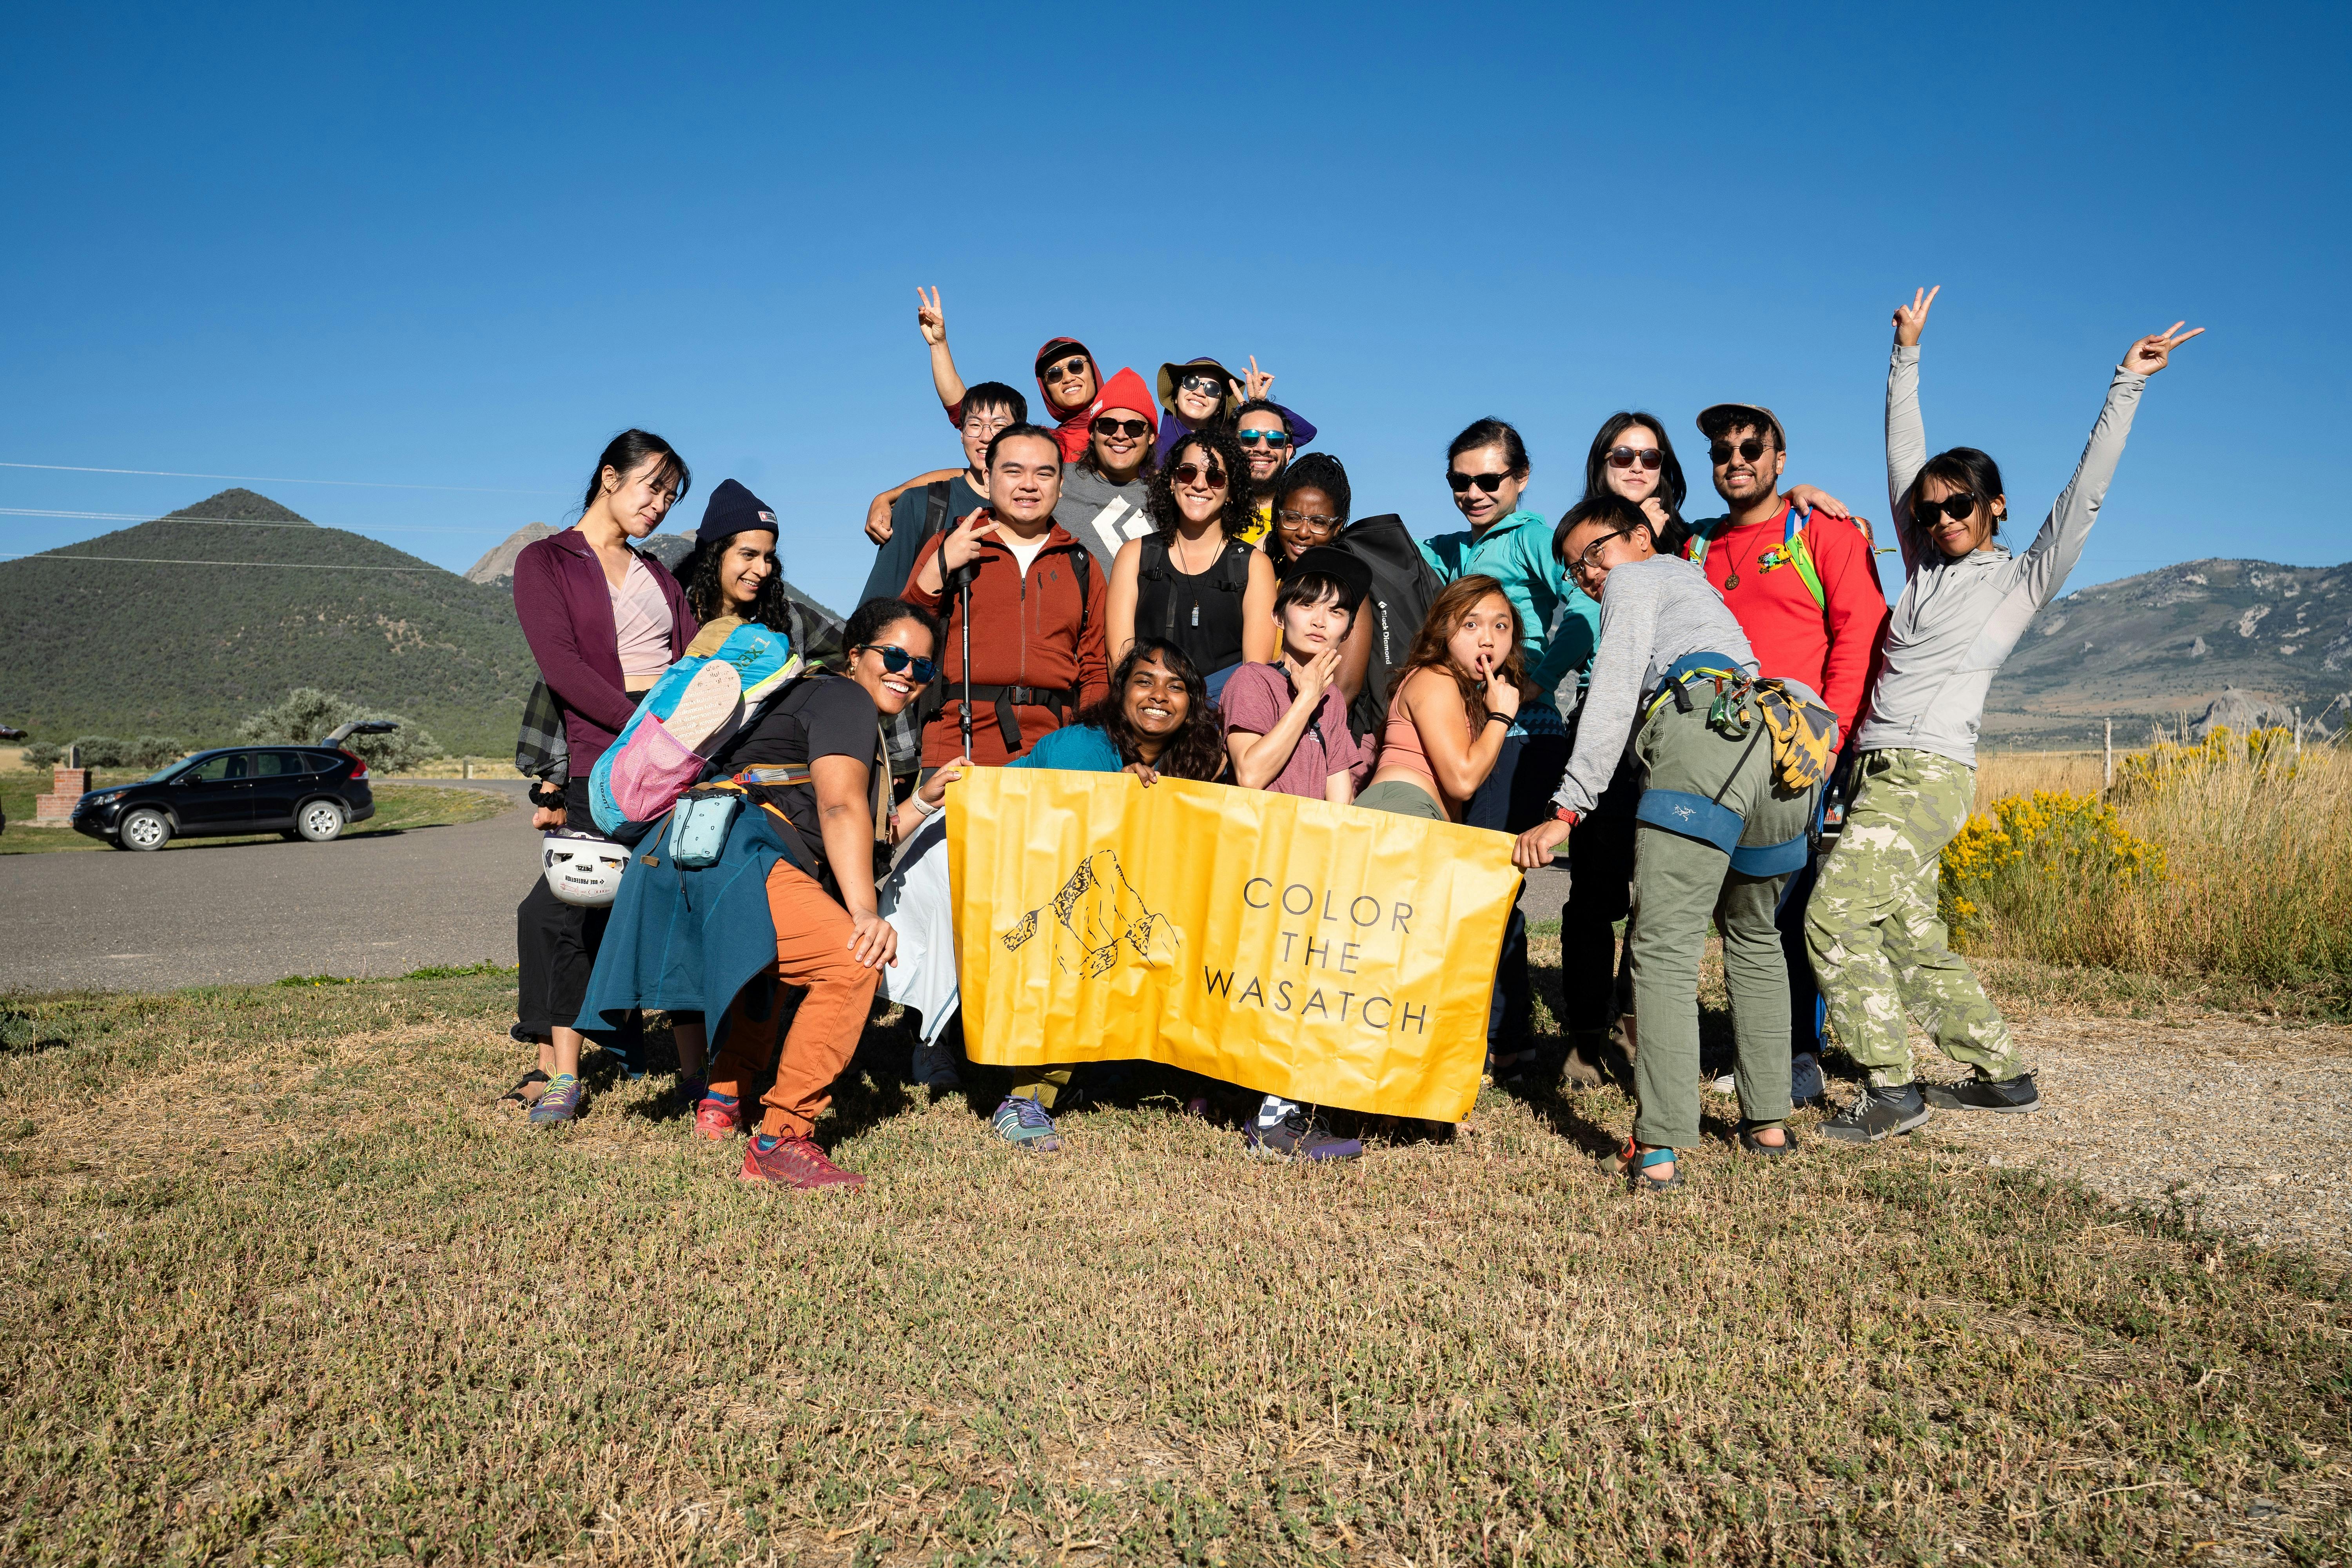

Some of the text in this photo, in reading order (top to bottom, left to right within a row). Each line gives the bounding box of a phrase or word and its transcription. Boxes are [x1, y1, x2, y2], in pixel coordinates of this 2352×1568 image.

[1383, 632, 1392, 664] Diamond
[565, 875, 588, 884] PROTECTION
[1243, 877, 1413, 934] COLOR
[1281, 931, 1361, 974] THE
[1205, 965, 1426, 1034] WASATCH
[768, 1166, 797, 1183] SPORTIVA
